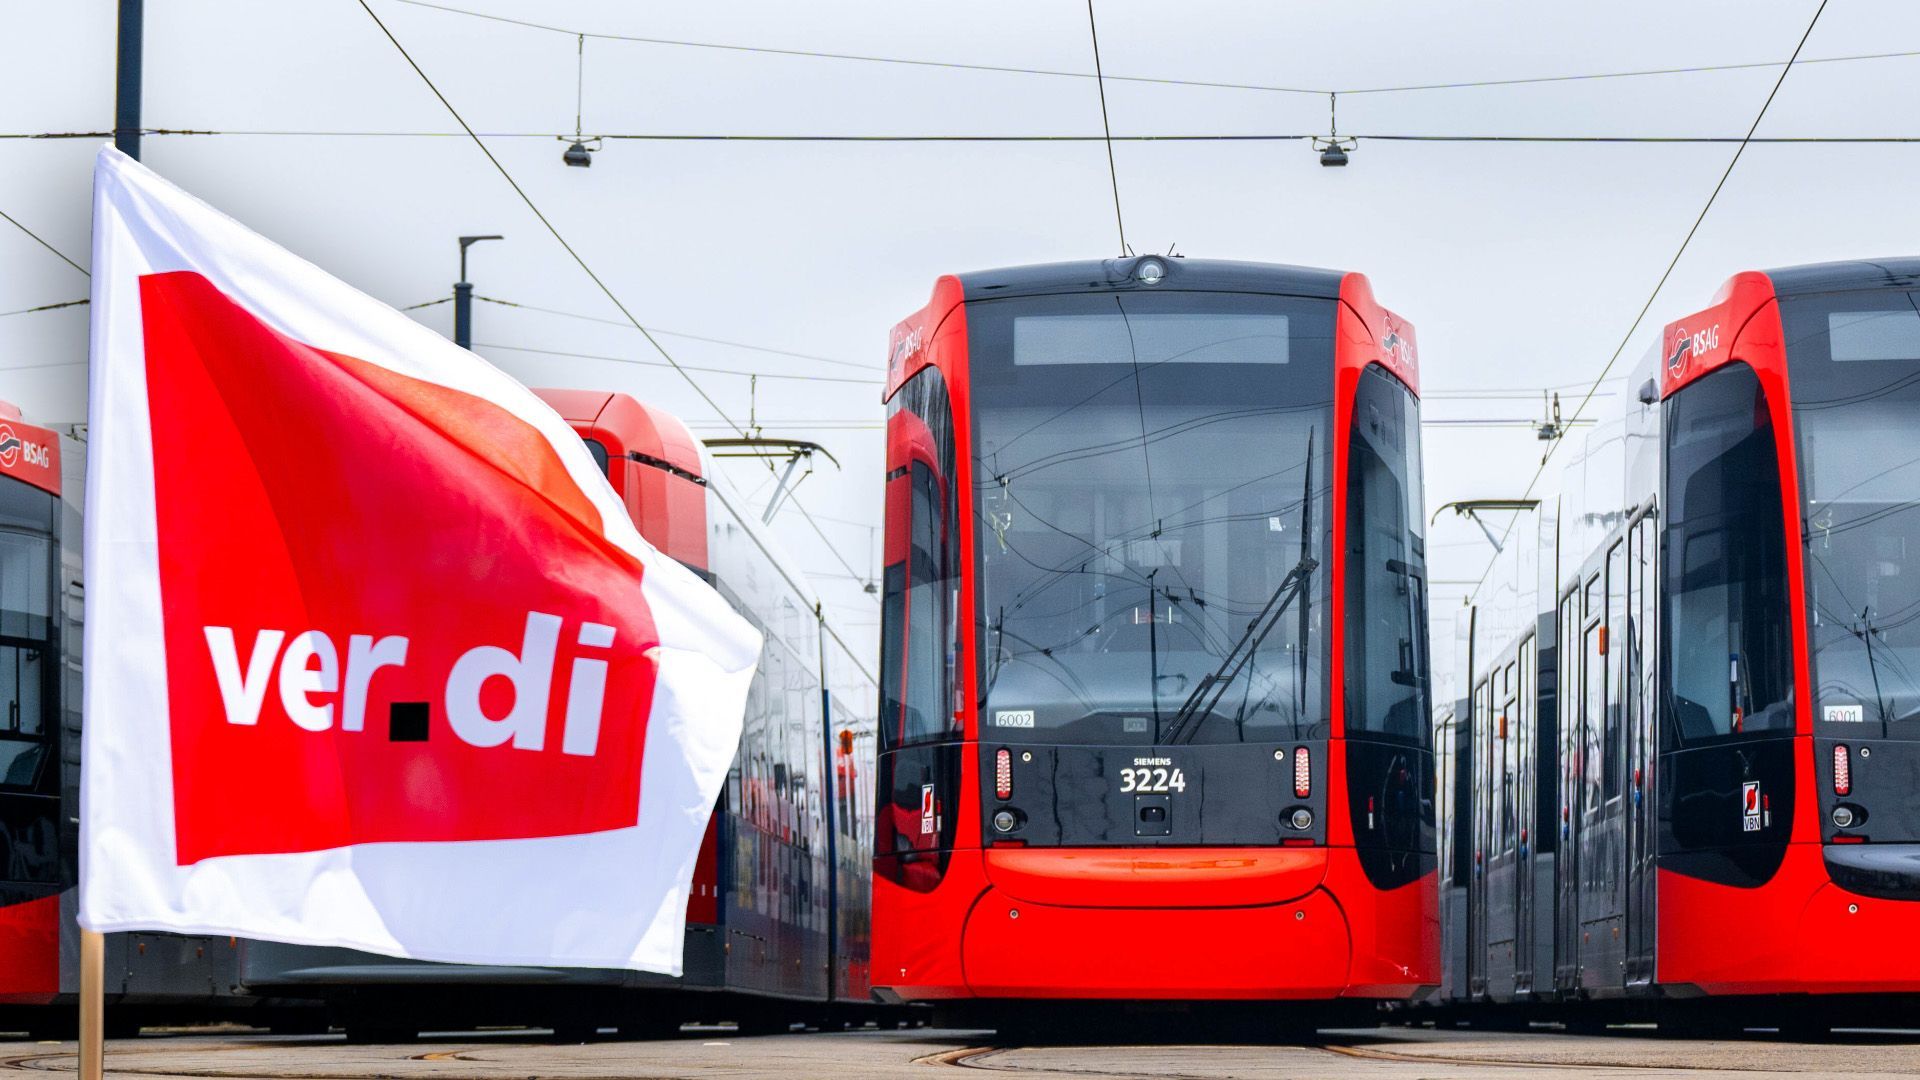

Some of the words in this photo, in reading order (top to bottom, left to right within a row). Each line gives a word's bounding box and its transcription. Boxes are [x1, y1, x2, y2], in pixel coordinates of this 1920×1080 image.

[905, 326, 923, 359] BSAG
[1692, 324, 1719, 358] BSAG
[24, 440, 49, 469] BSAG
[203, 610, 617, 757] ver.di
[998, 714, 1031, 727] 6002
[1829, 710, 1856, 722] 6001
[1133, 757, 1172, 766] SIEMENS
[1120, 768, 1186, 793] 3224
[922, 820, 934, 833] VBN
[1744, 816, 1760, 830] VBN
